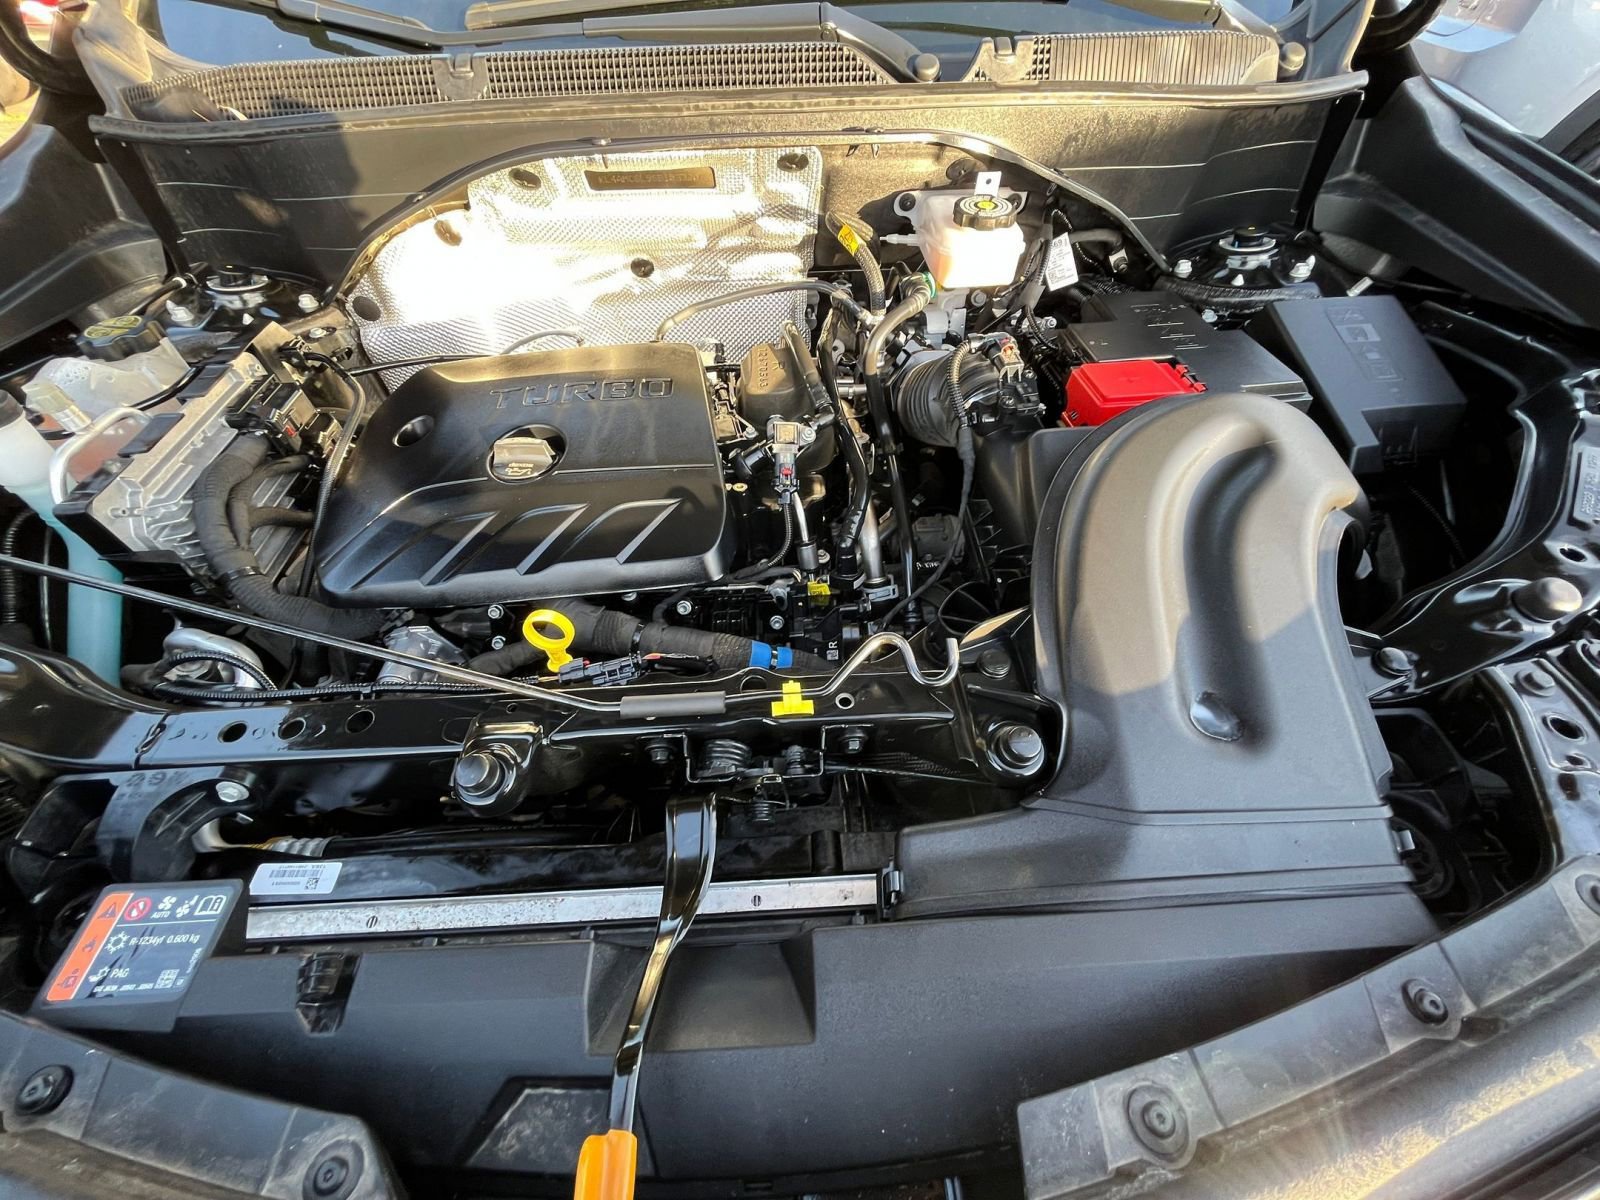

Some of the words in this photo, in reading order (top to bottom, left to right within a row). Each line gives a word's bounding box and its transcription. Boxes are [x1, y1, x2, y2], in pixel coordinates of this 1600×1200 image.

[489, 376, 674, 409] TURBO
[150, 910, 171, 919] AUTO
[129, 935, 166, 947] R-1234yf
[166, 934, 189, 944] 0.600
[189, 933, 200, 944] kg
[110, 967, 130, 978] PAG
